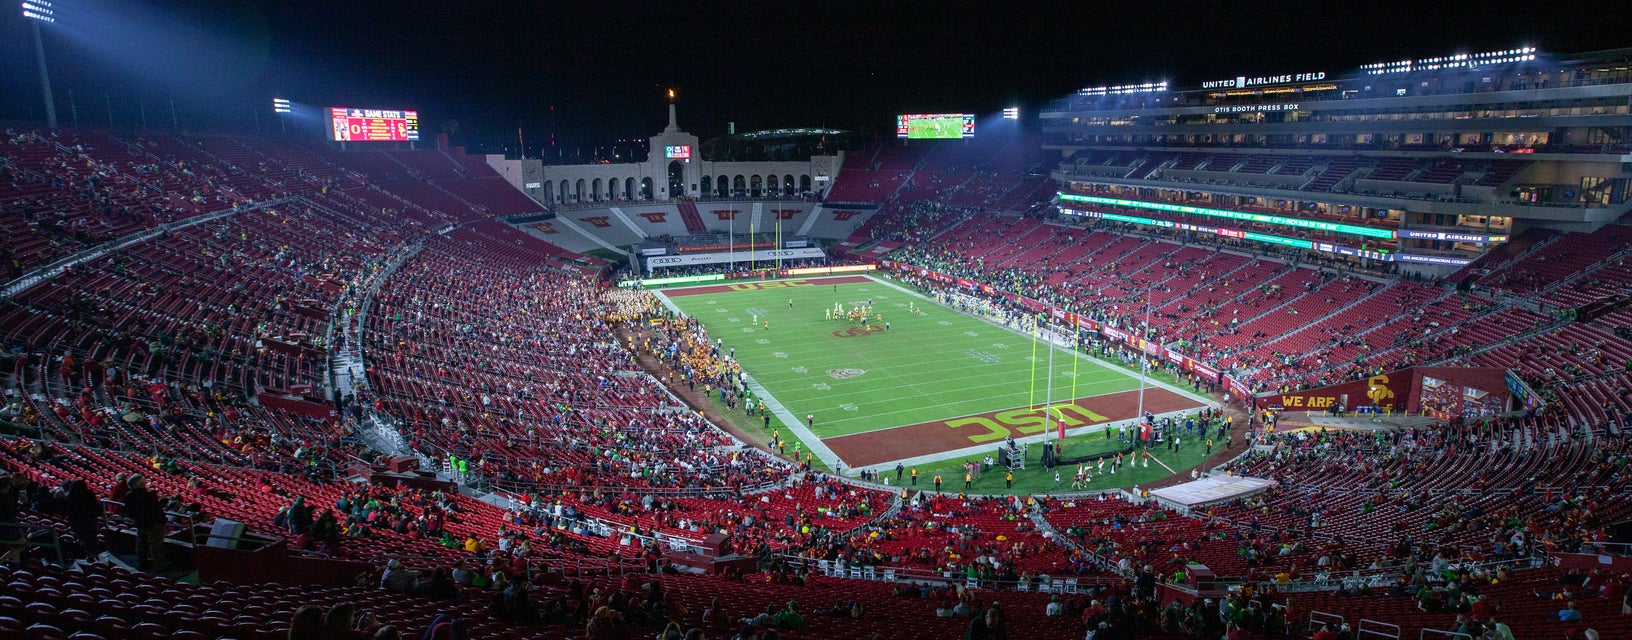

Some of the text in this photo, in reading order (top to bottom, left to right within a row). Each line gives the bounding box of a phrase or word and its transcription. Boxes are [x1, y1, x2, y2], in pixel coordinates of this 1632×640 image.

[1202, 72, 1326, 89] UNITED AIRLINES FIELD
[364, 110, 382, 118] GAME
[383, 110, 401, 118] STATS
[1446, 233, 1483, 241] AIRLINES
[728, 280, 815, 291] USC
[1424, 377, 1436, 387] 34
[1467, 388, 1477, 397] 11
[1281, 396, 1336, 408] WE ARE
[944, 404, 1109, 444] USC
